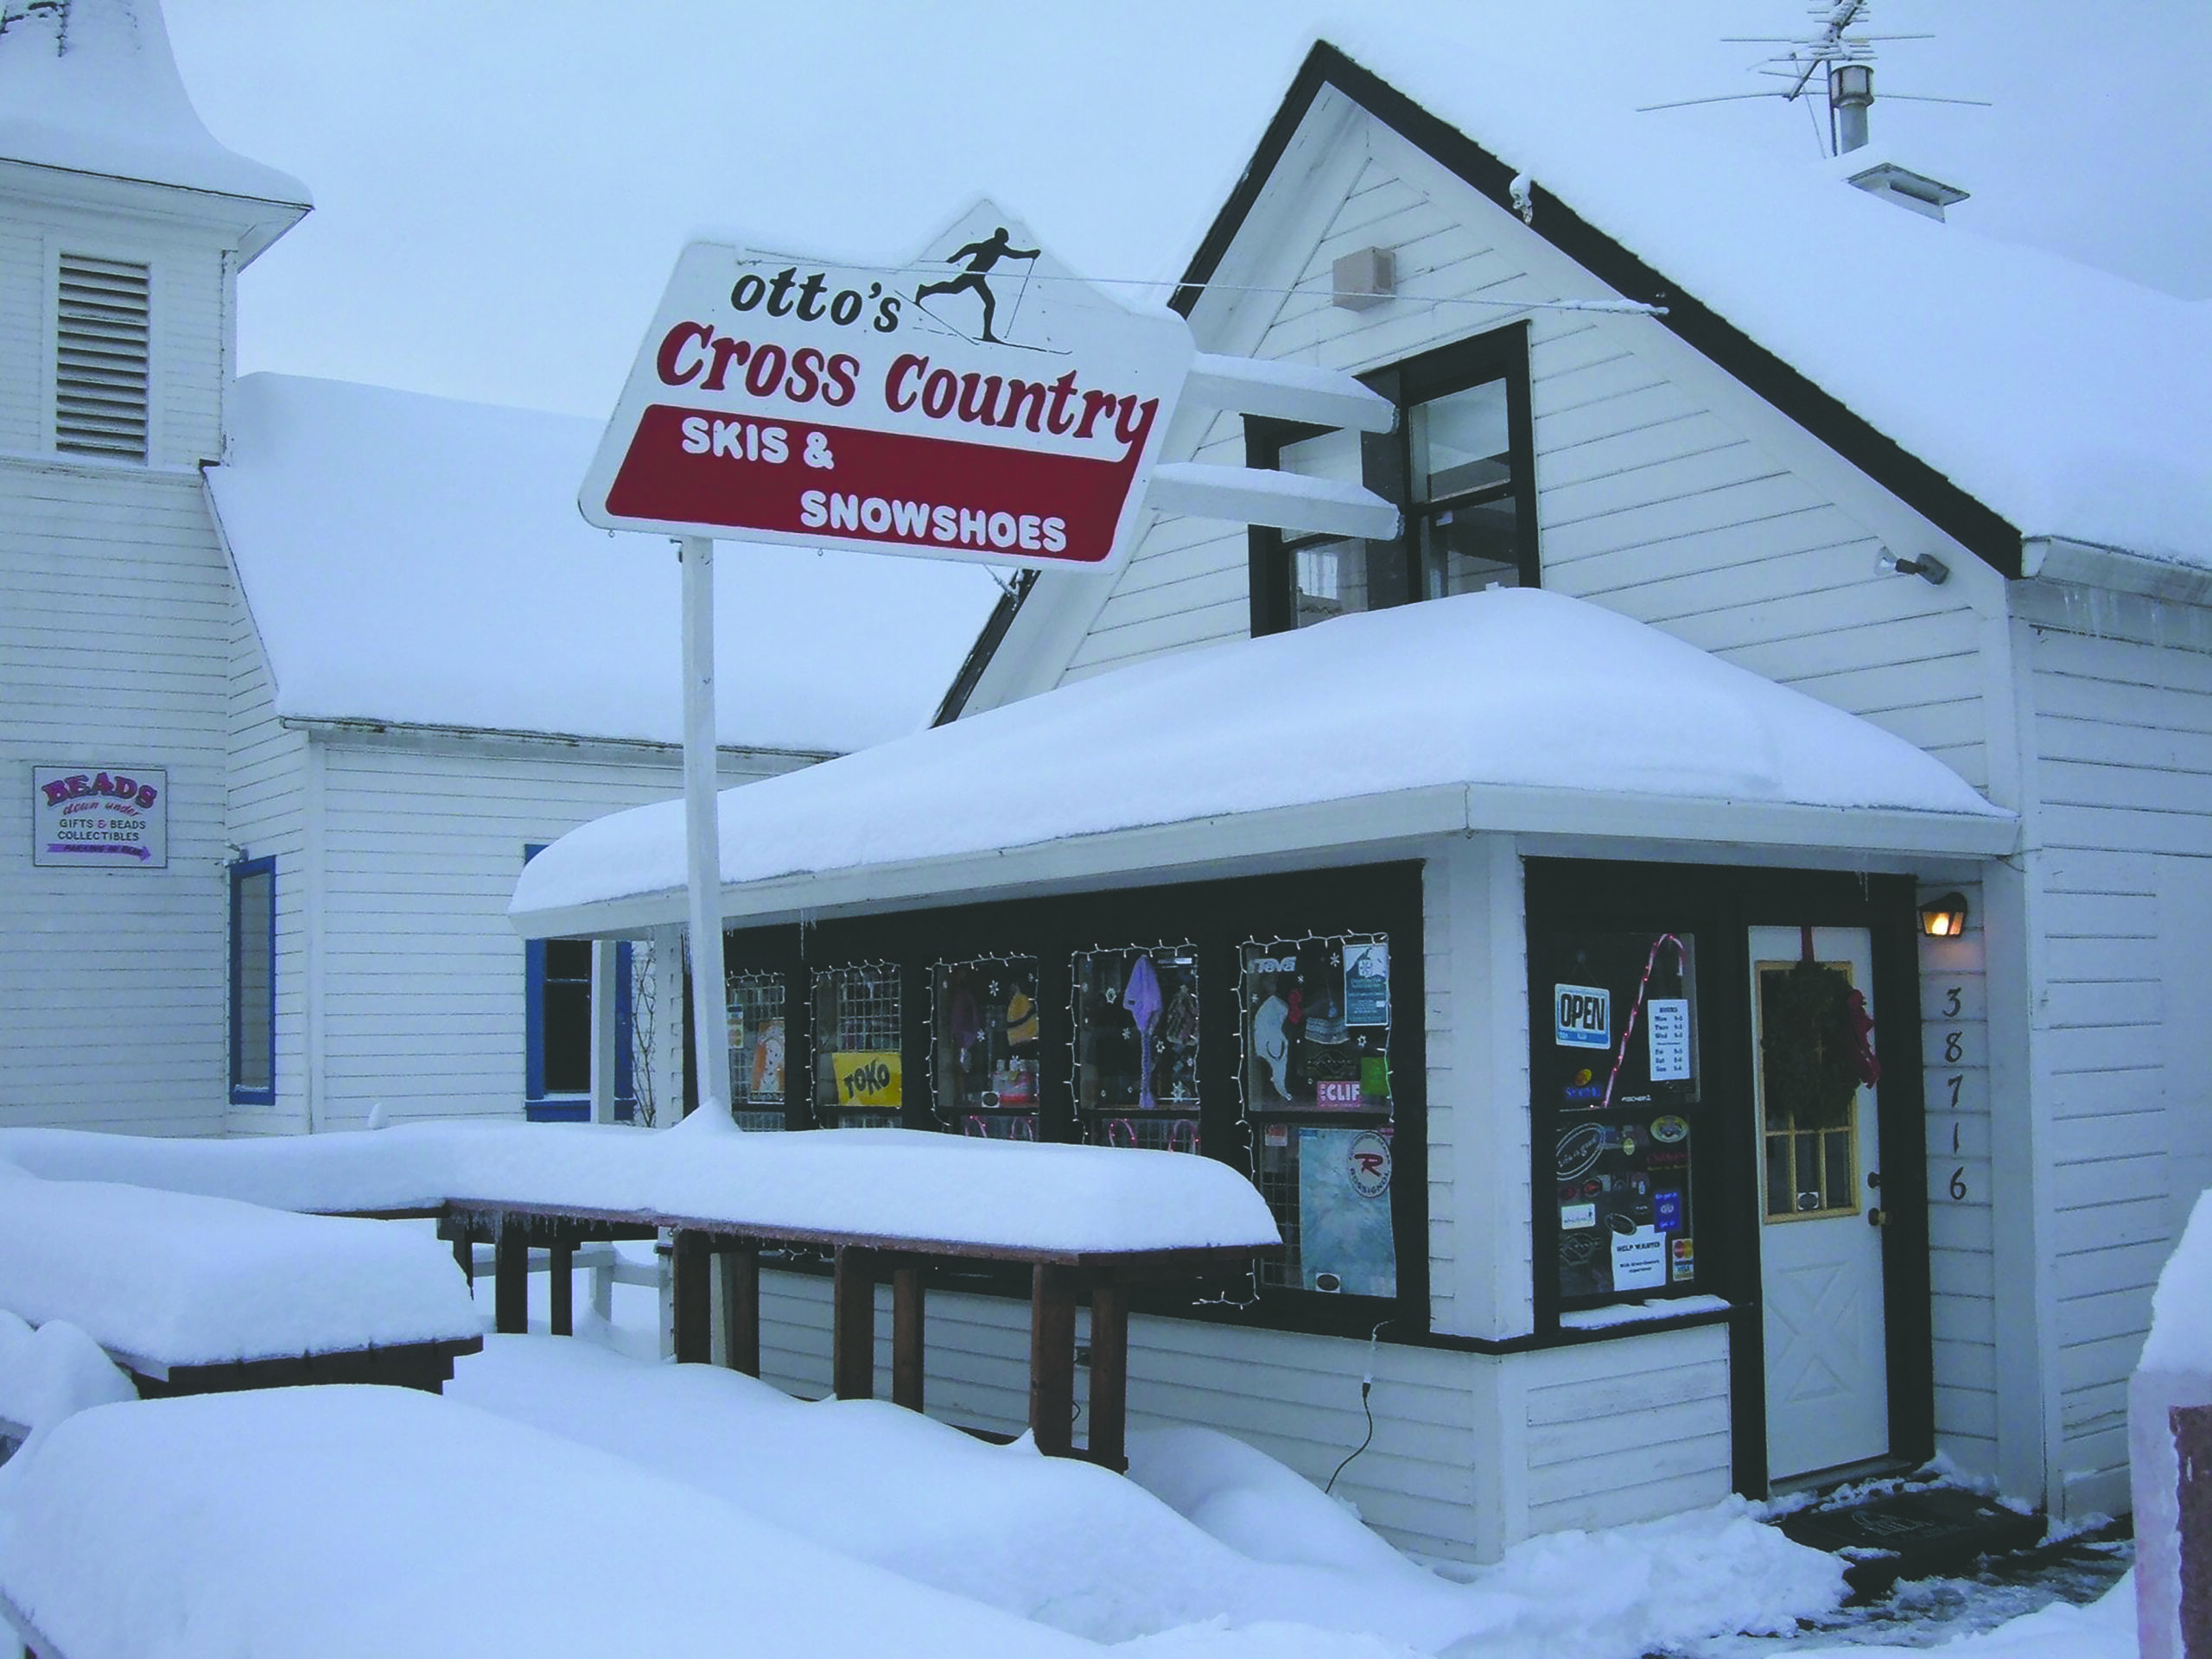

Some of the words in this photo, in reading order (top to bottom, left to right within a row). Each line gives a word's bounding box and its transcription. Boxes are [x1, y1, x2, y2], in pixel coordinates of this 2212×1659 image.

[729, 267, 902, 334] otto's
[657, 321, 860, 406] Cross
[884, 353, 1160, 445] Country
[681, 416, 790, 464] SKIS
[804, 432, 835, 469] &
[800, 490, 1067, 553] SNOWSHOES
[41, 772, 158, 809] BEADS
[60, 819, 93, 829] GIFTS
[111, 819, 145, 830] BEADS
[105, 802, 143, 817] under
[58, 831, 139, 842] COLLECTIBLES
[1560, 994, 1605, 1031] OPEN
[842, 1059, 890, 1098] TOKO
[1326, 1084, 1360, 1102] CLIF
